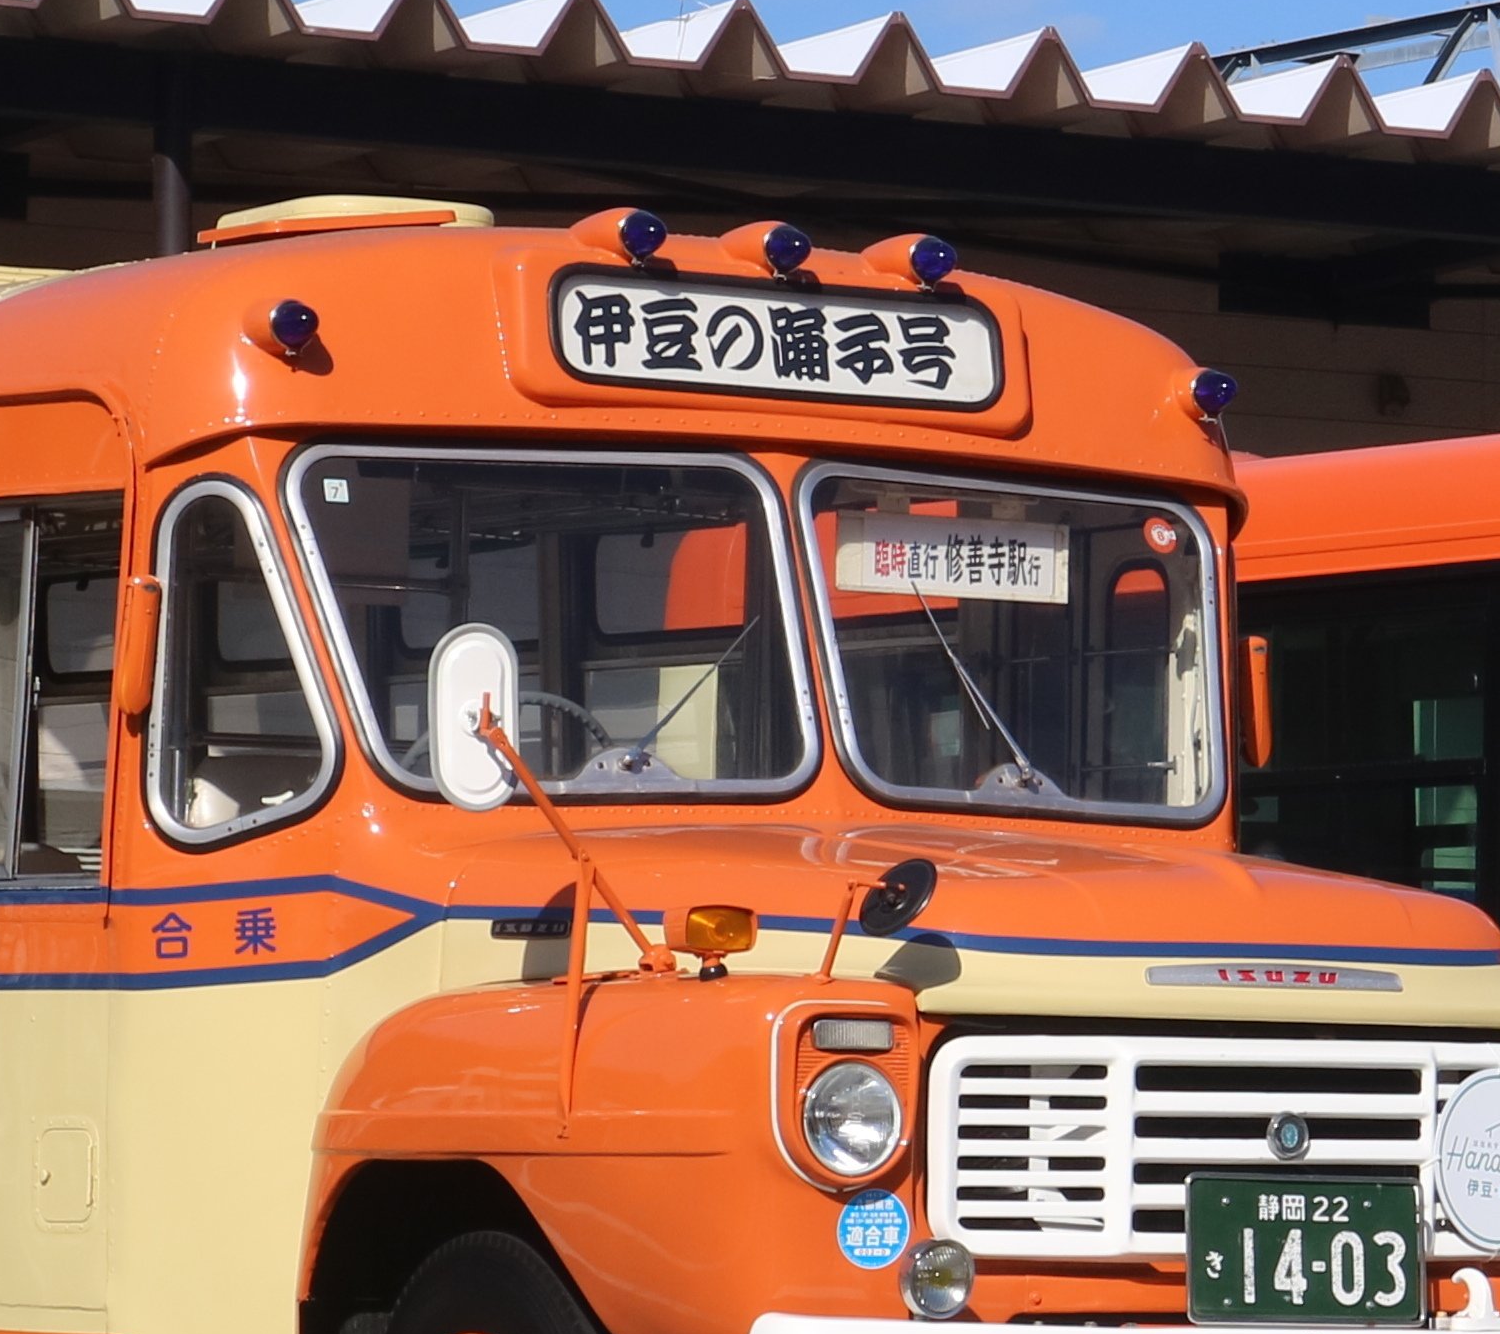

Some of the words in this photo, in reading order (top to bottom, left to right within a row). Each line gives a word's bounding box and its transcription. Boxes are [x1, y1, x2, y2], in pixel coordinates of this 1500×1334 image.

[573, 289, 957, 390] 伊豆の踊子号
[1218, 969, 1338, 985] ISUZU
[1312, 1196, 1350, 1223] 22
[845, 1225, 901, 1247] 適合車
[1242, 1227, 1407, 1308] 14-03
